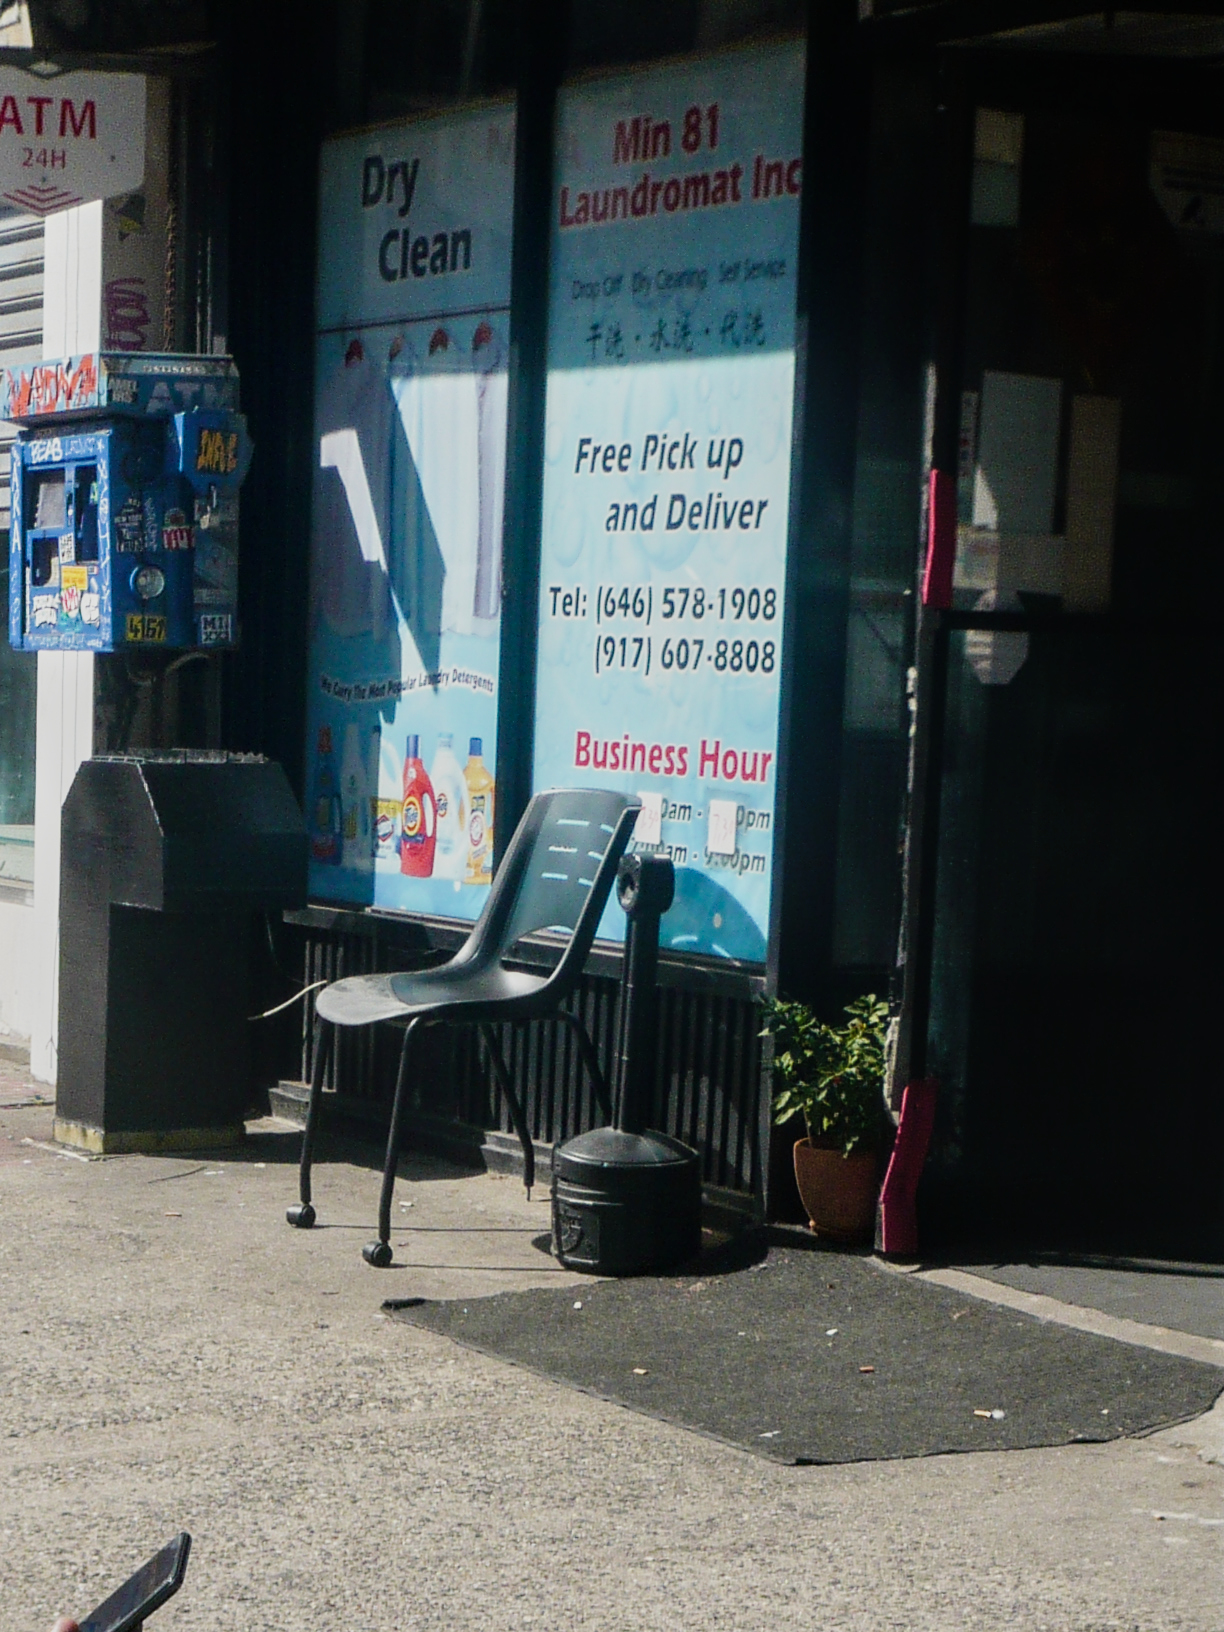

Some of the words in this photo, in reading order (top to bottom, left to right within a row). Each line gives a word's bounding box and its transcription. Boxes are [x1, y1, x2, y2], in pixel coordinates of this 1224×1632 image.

[613, 114, 671, 165] Min
[681, 102, 720, 153] 81
[22, 148, 67, 169] 24H
[361, 154, 421, 218] Dry
[559, 163, 744, 228] Laundromat
[751, 154, 802, 200] Inc
[378, 227, 472, 282] Clean
[574, 437, 632, 474] Free
[640, 432, 698, 472] Pick
[706, 437, 744, 480] up
[605, 494, 658, 532] and
[665, 492, 769, 531] Deliver
[549, 586, 587, 617] Tel:
[597, 585, 652, 626] (646)
[595, 635, 652, 676] (917)
[451, 668, 494, 693] Detergents
[575, 731, 689, 776] Business
[698, 739, 772, 783] Hour
